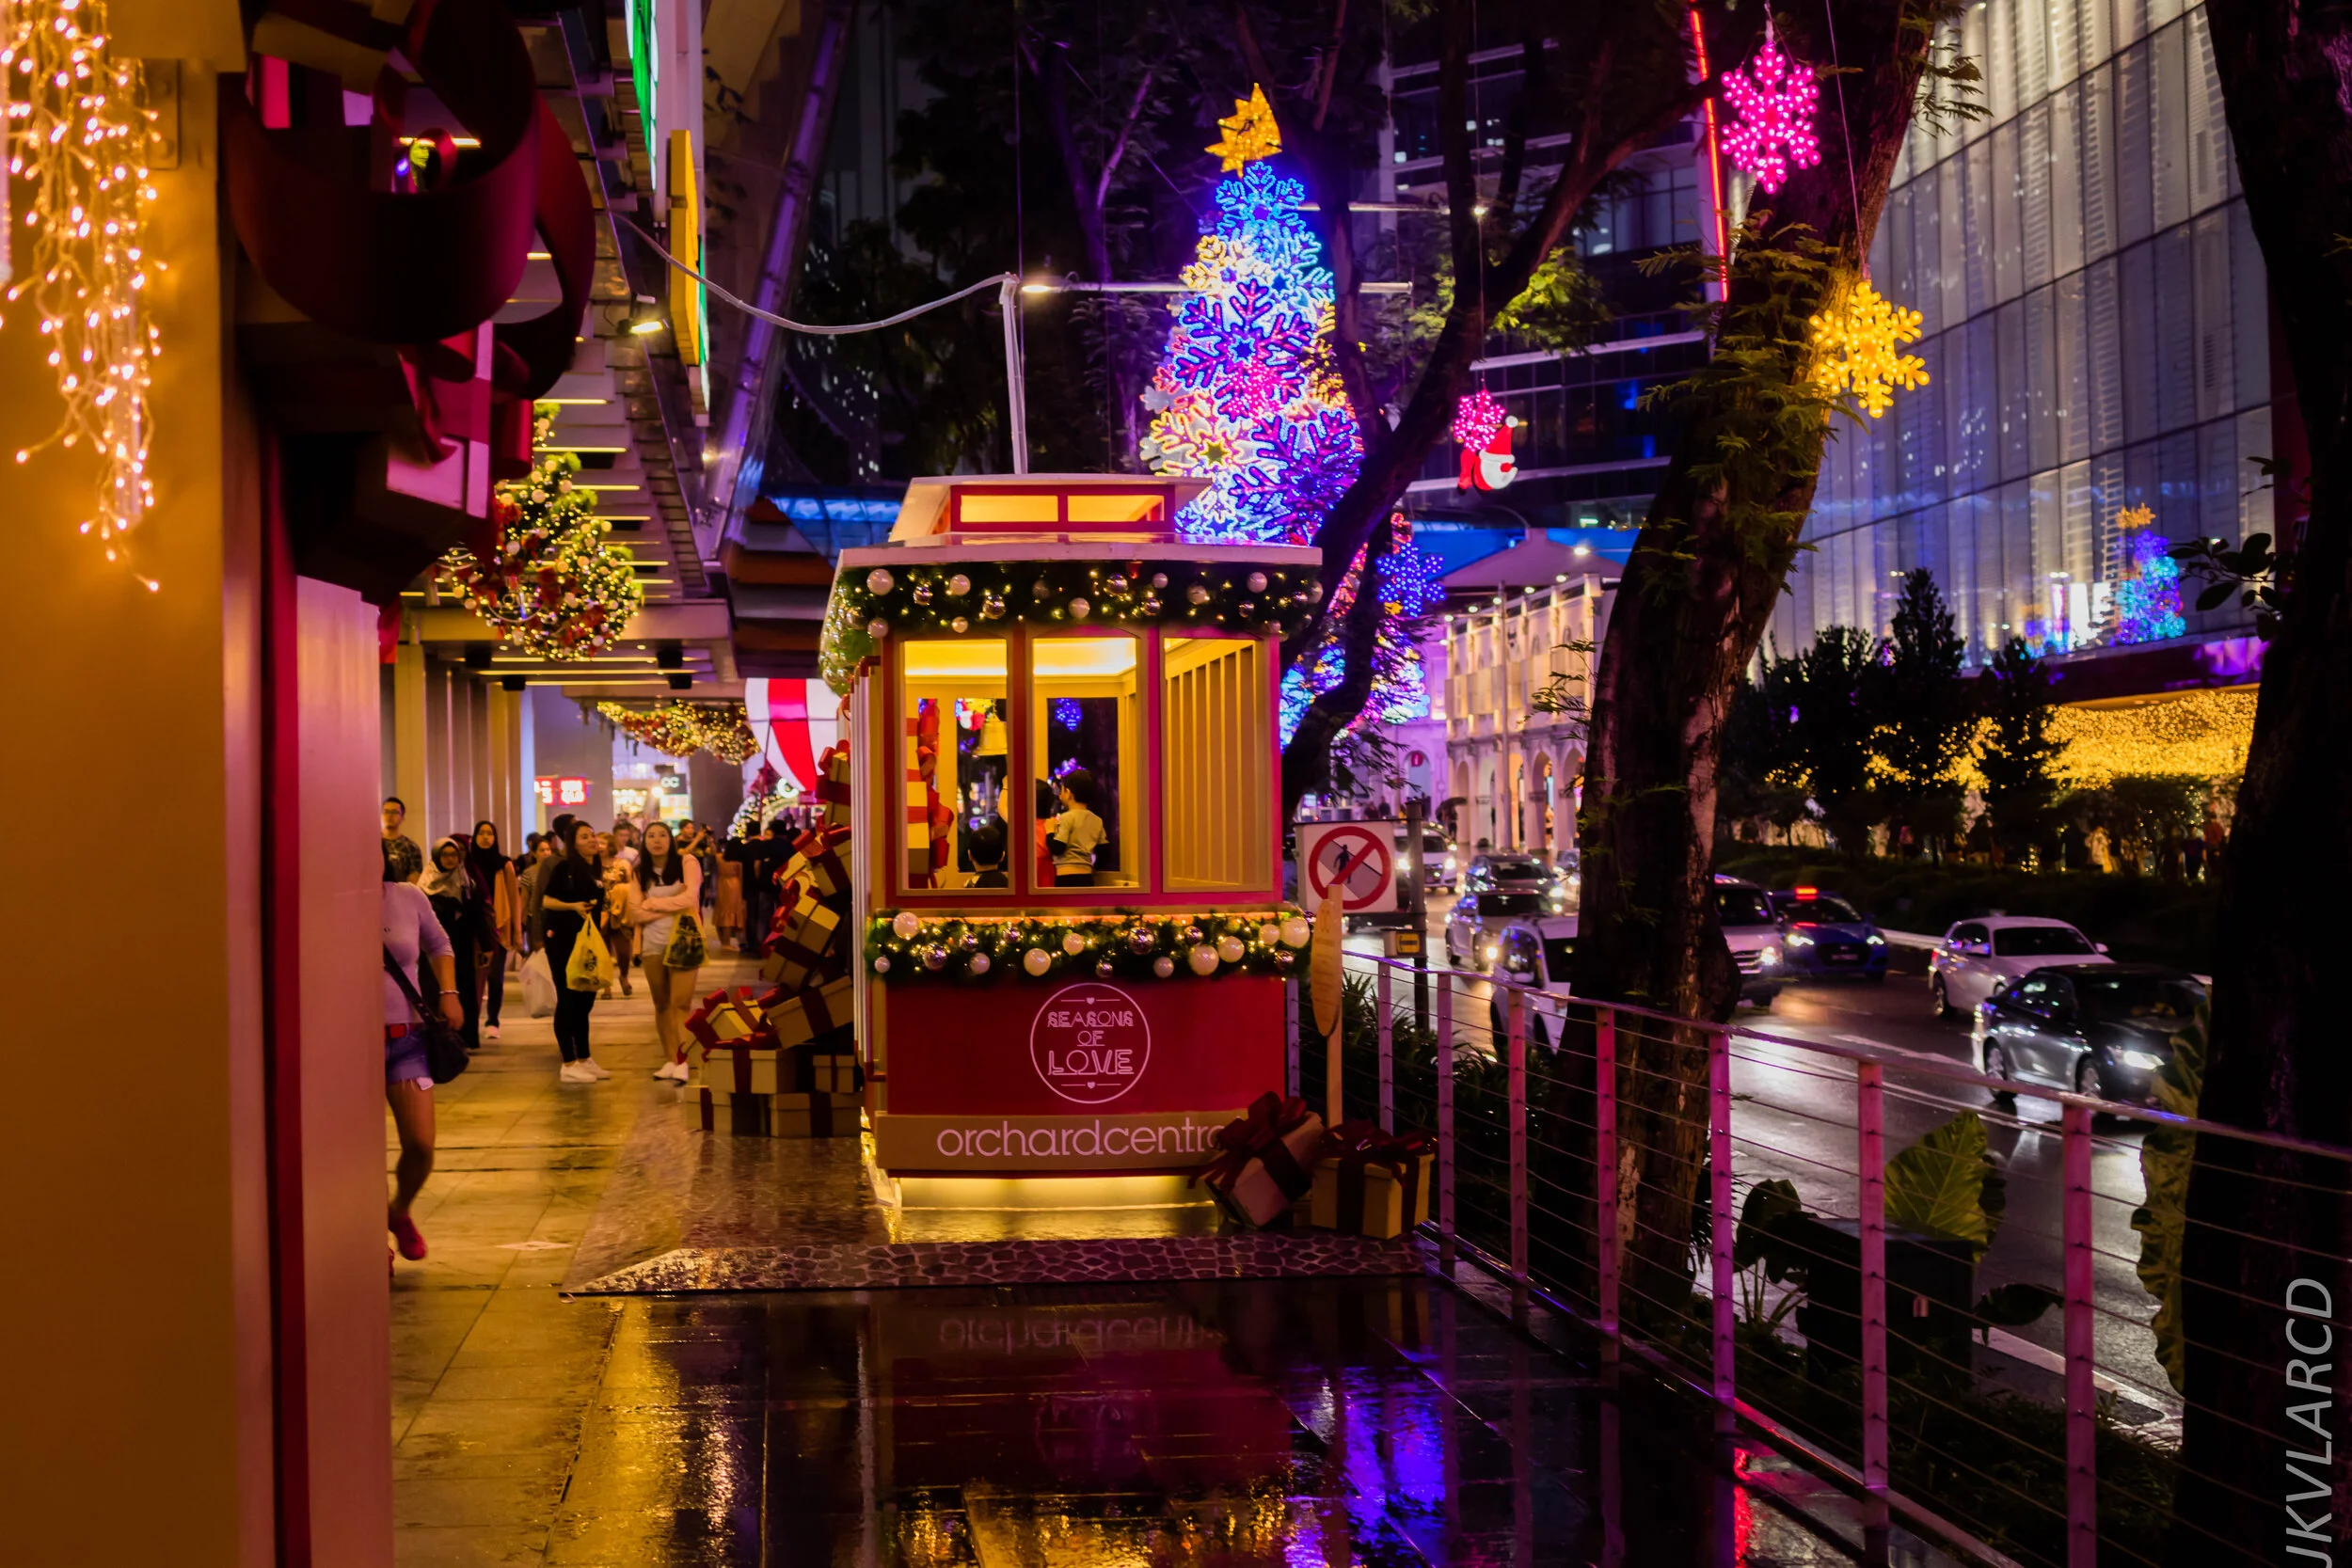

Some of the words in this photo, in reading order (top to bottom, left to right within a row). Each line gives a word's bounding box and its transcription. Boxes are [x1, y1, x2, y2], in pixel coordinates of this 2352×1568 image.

[1047, 1010, 1134, 1028] SEASONS
[1076, 1030, 1105, 1047] OF
[1047, 1049, 1135, 1076] LOVE
